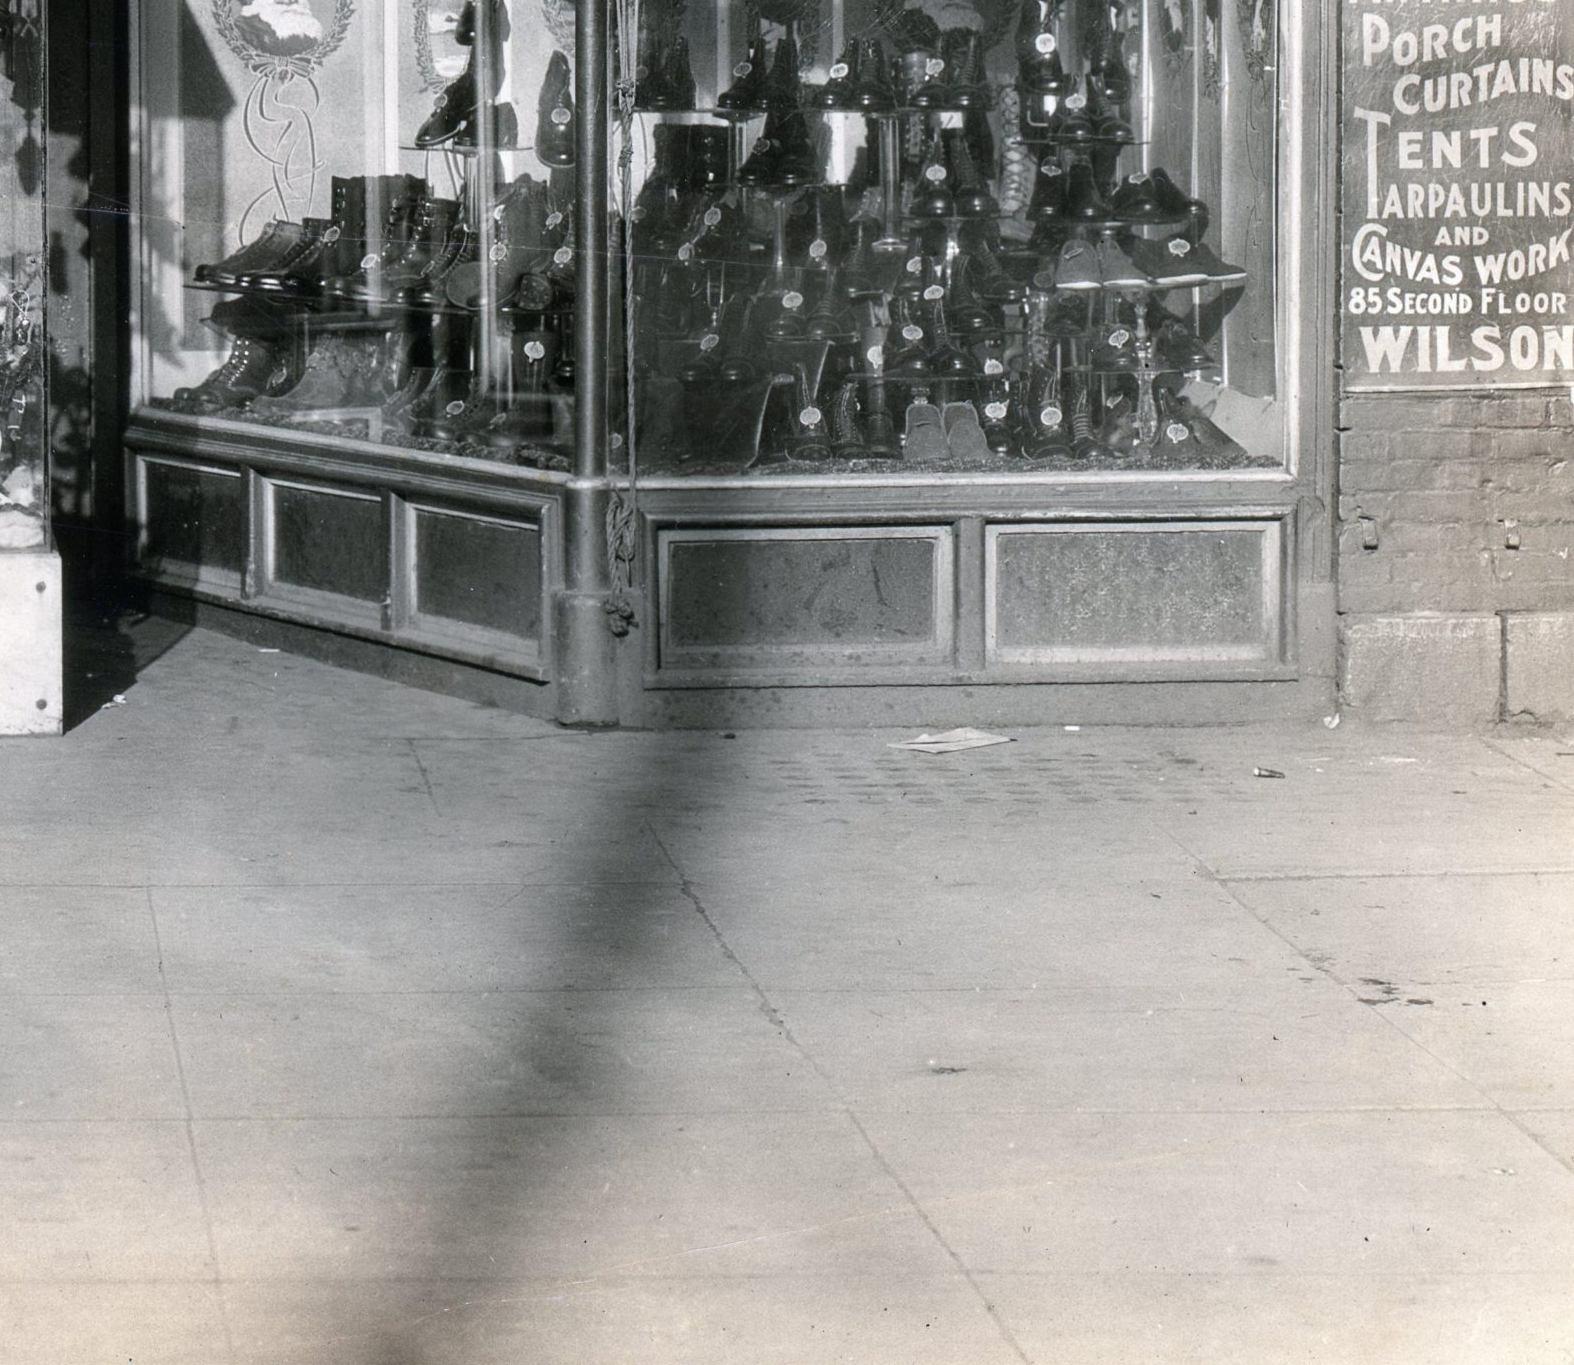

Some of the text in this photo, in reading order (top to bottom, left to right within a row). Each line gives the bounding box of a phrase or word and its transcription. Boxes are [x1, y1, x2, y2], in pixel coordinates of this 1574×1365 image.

[1362, 13, 1502, 67] PORCH
[1393, 58, 1574, 115] CURTAINS
[1354, 106, 1538, 171] TENTS
[1365, 181, 1572, 220] TARPAULINS
[1352, 222, 1573, 286] CANVAS WORK
[1434, 226, 1490, 247] AND
[1348, 287, 1567, 315] 85 SECOND FLOOR
[1359, 324, 1574, 374] WILSON
